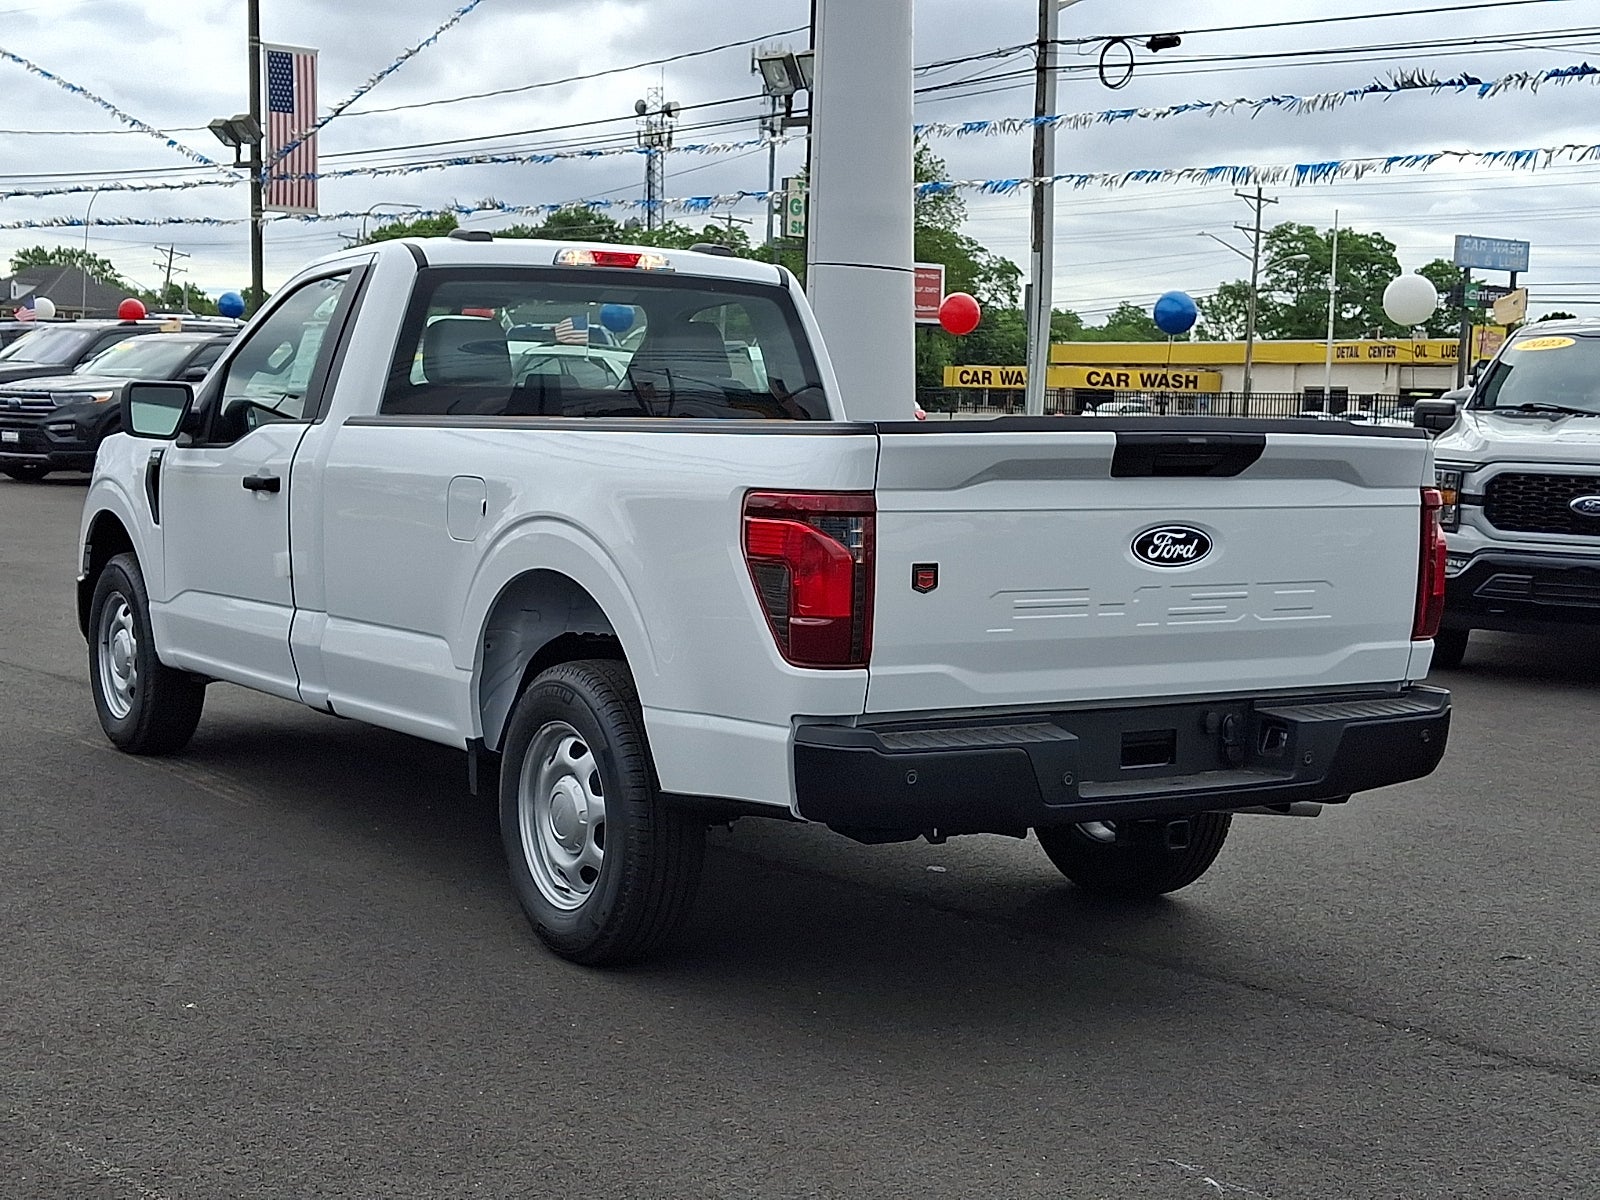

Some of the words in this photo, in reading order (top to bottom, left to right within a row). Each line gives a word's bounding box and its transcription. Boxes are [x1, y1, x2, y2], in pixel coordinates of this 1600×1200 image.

[1463, 238, 1487, 252] CAR
[1492, 241, 1525, 256] WASH
[1336, 345, 1360, 358] DETAIL
[1368, 345, 1397, 358] CENTER
[1414, 344, 1428, 358] OIL
[959, 369, 993, 385] CAR
[999, 370, 1028, 386] WA
[1086, 370, 1130, 388] CAR
[1139, 372, 1199, 390] WASH
[1147, 530, 1200, 560] Ford
